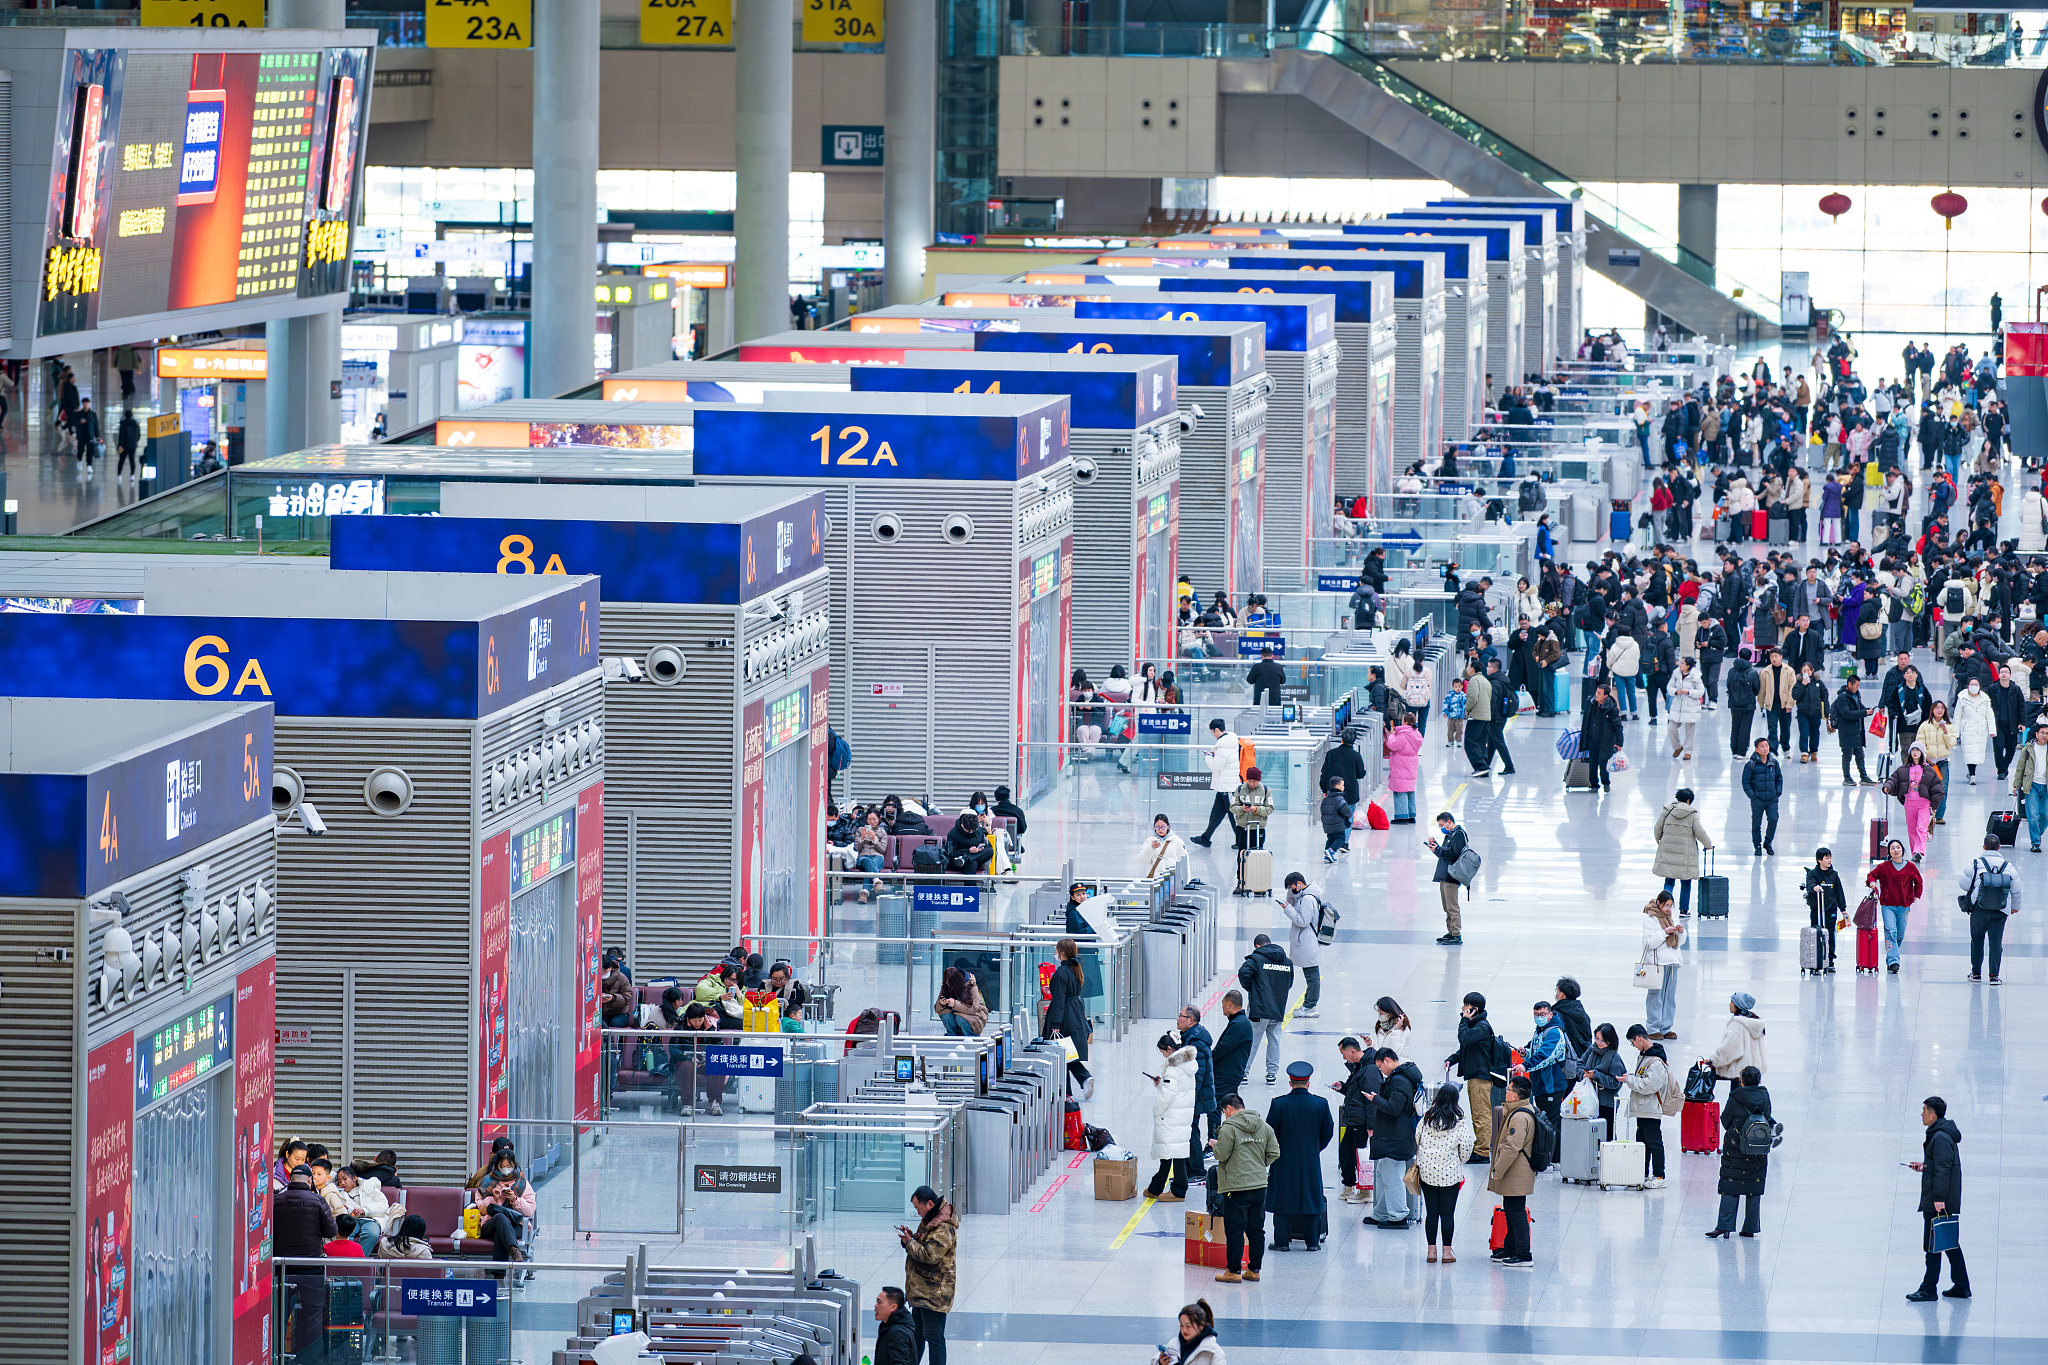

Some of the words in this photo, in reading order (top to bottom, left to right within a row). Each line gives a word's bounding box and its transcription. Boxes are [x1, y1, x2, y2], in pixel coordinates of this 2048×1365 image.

[466, 16, 521, 41] 23A
[675, 16, 724, 37] 27A
[834, 17, 876, 37] 30A
[810, 424, 898, 467] 12A
[1020, 426, 1029, 466] 12A
[811, 509, 820, 556] 9A
[496, 534, 568, 575] 8A
[747, 535, 756, 584] 8A
[579, 600, 590, 656] 7A
[183, 635, 273, 697] 6A
[487, 635, 500, 696] 6A
[181, 759, 202, 801] 检票口
[243, 732, 260, 802] 5A
[100, 790, 118, 864] 4A
[917, 893, 950, 901] 便捷换乘
[218, 1011, 228, 1051] 5A
[281, 1030, 308, 1038] 消防栓
[138, 1054, 149, 1094] 4A
[710, 1053, 748, 1063] 便捷换乘
[719, 1171, 777, 1182] 请勿翻越栏杆
[407, 1288, 454, 1300] 便捷换乘
